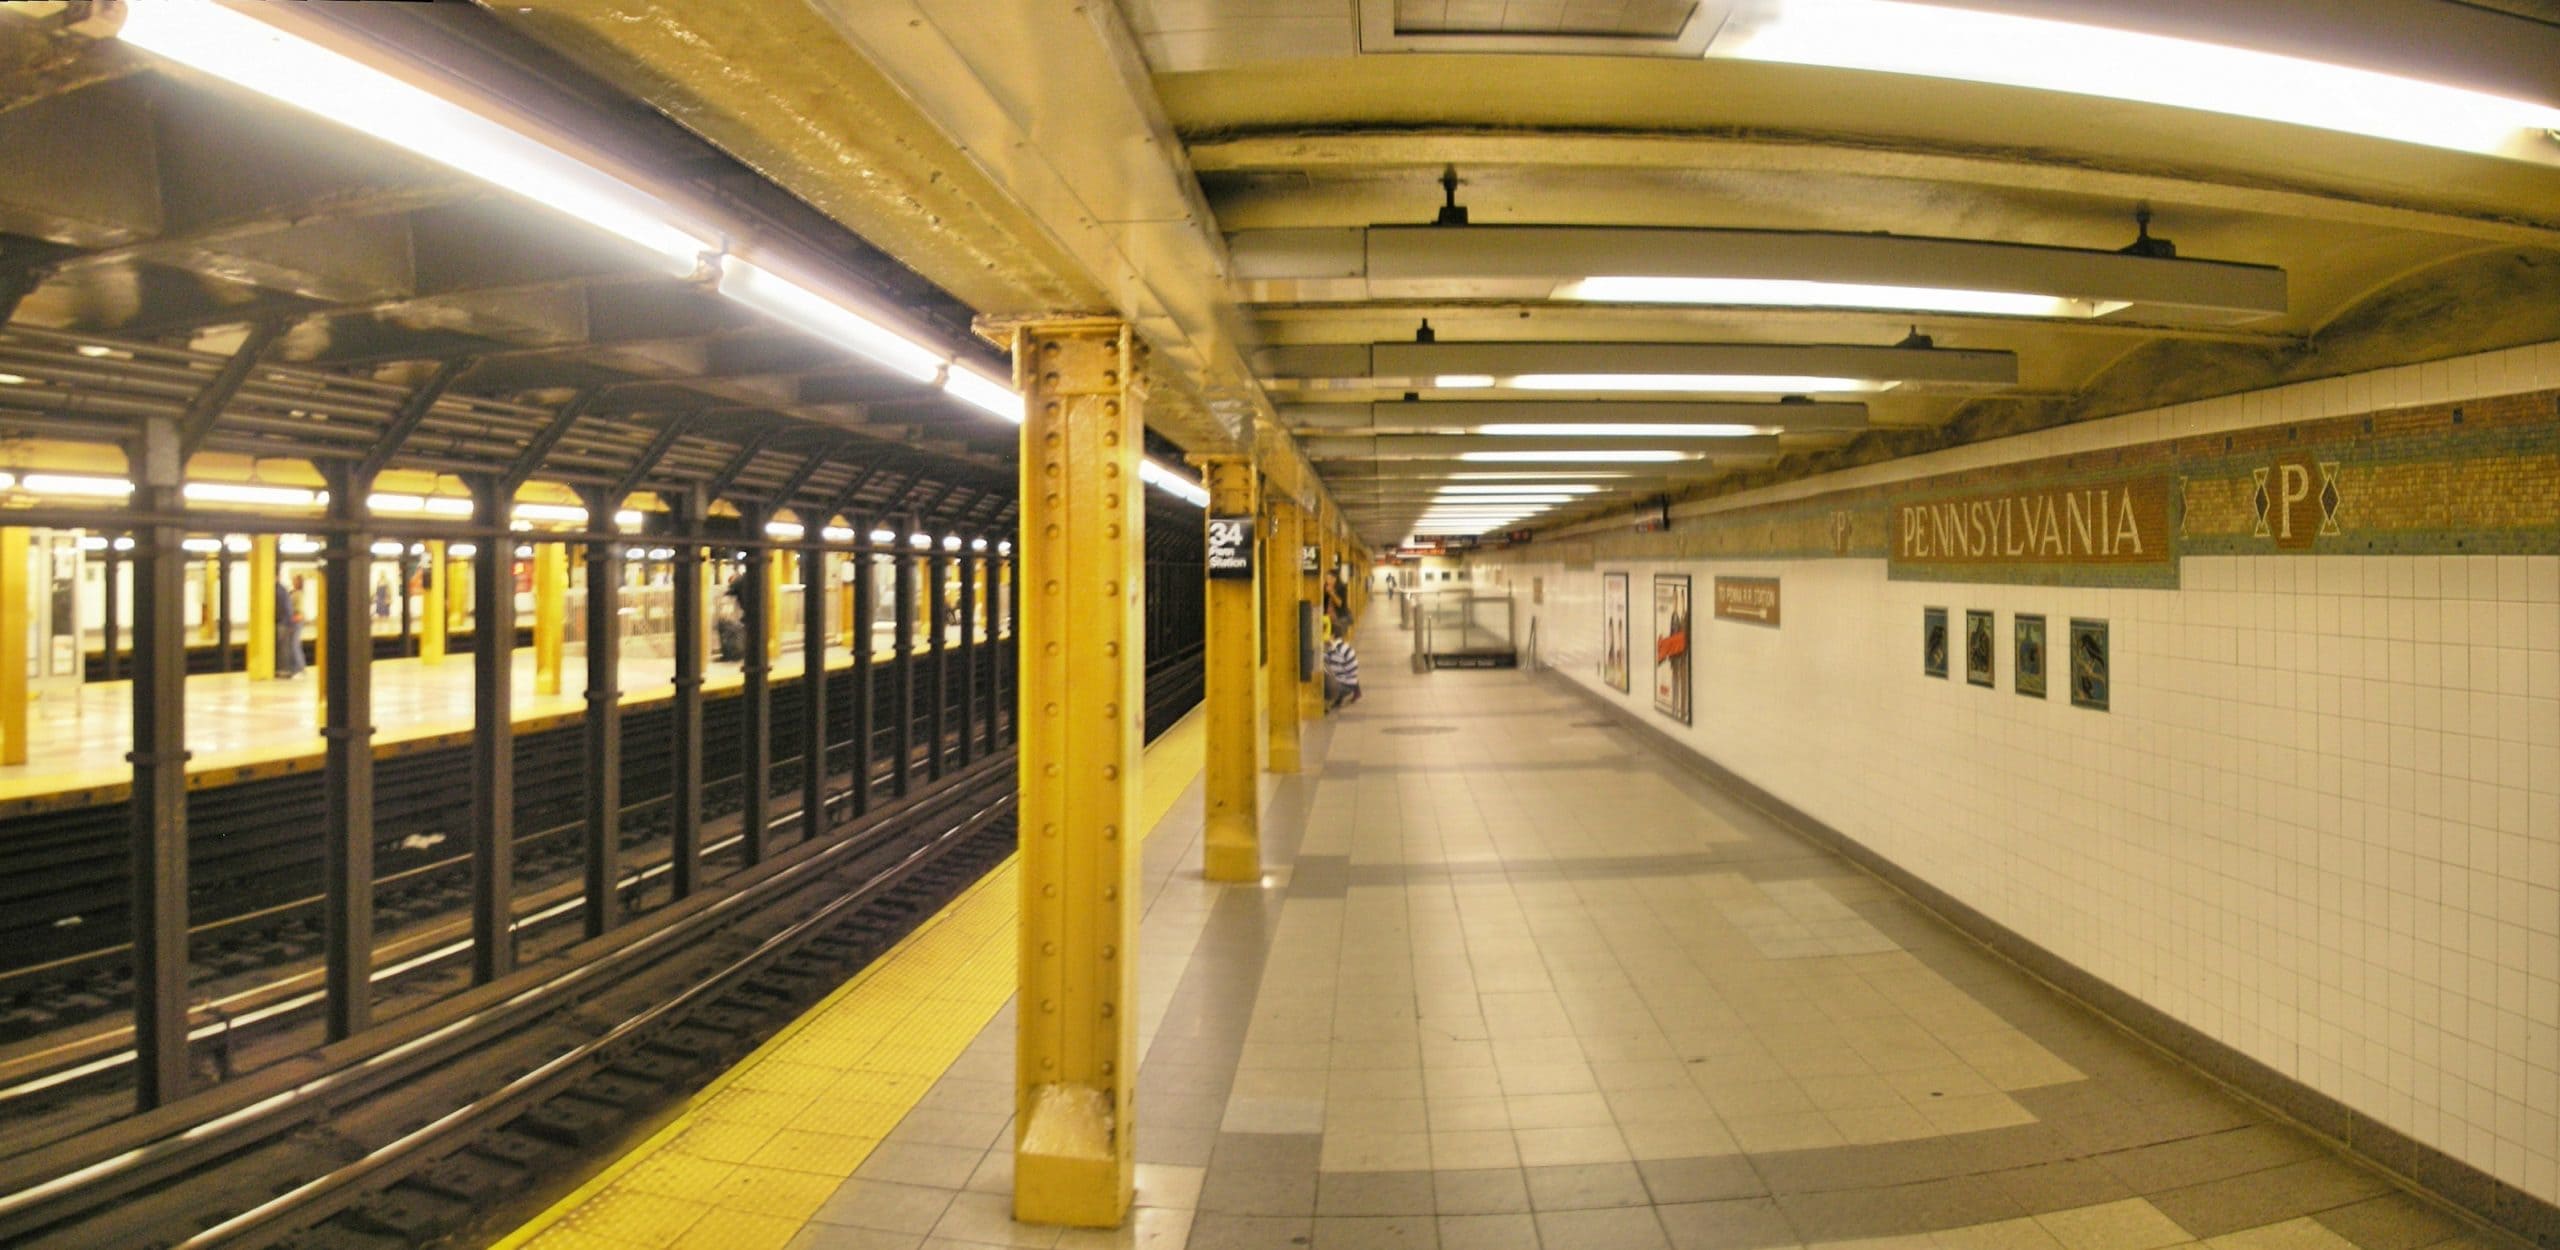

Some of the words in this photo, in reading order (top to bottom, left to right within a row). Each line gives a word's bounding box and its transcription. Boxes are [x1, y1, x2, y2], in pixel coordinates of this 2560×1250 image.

[2280, 464, 2309, 538] P
[1209, 522, 1243, 546] 34
[1836, 511, 1846, 551] P
[1903, 487, 2143, 557] PENNSYLVANIA
[1210, 557, 1247, 569] Station
